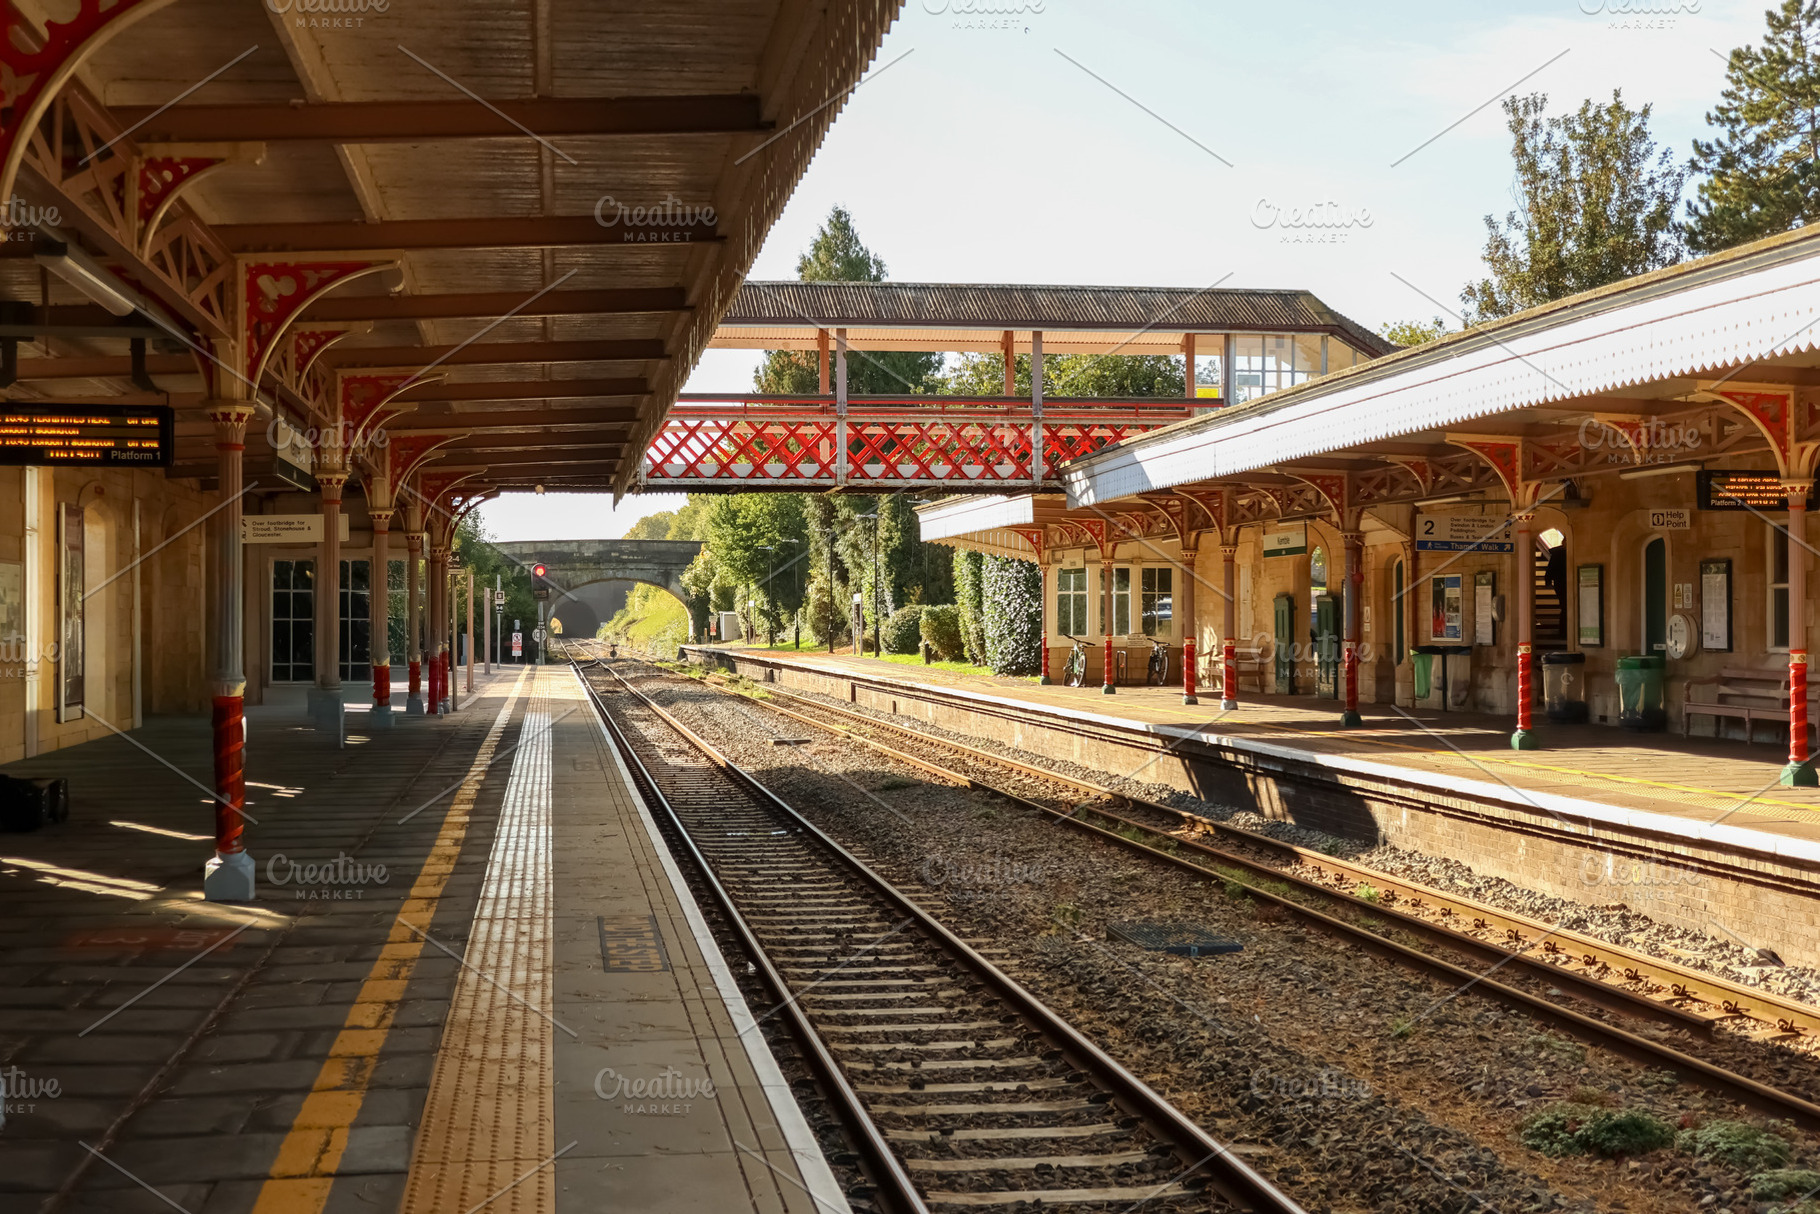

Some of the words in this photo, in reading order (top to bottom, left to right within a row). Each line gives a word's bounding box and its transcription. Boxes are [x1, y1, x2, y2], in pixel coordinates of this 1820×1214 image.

[111, 450, 152, 460] Platform
[156, 451, 160, 460] 1
[1424, 520, 1435, 535] 2
[1666, 520, 1687, 528] Point
[608, 948, 662, 971] STEP
